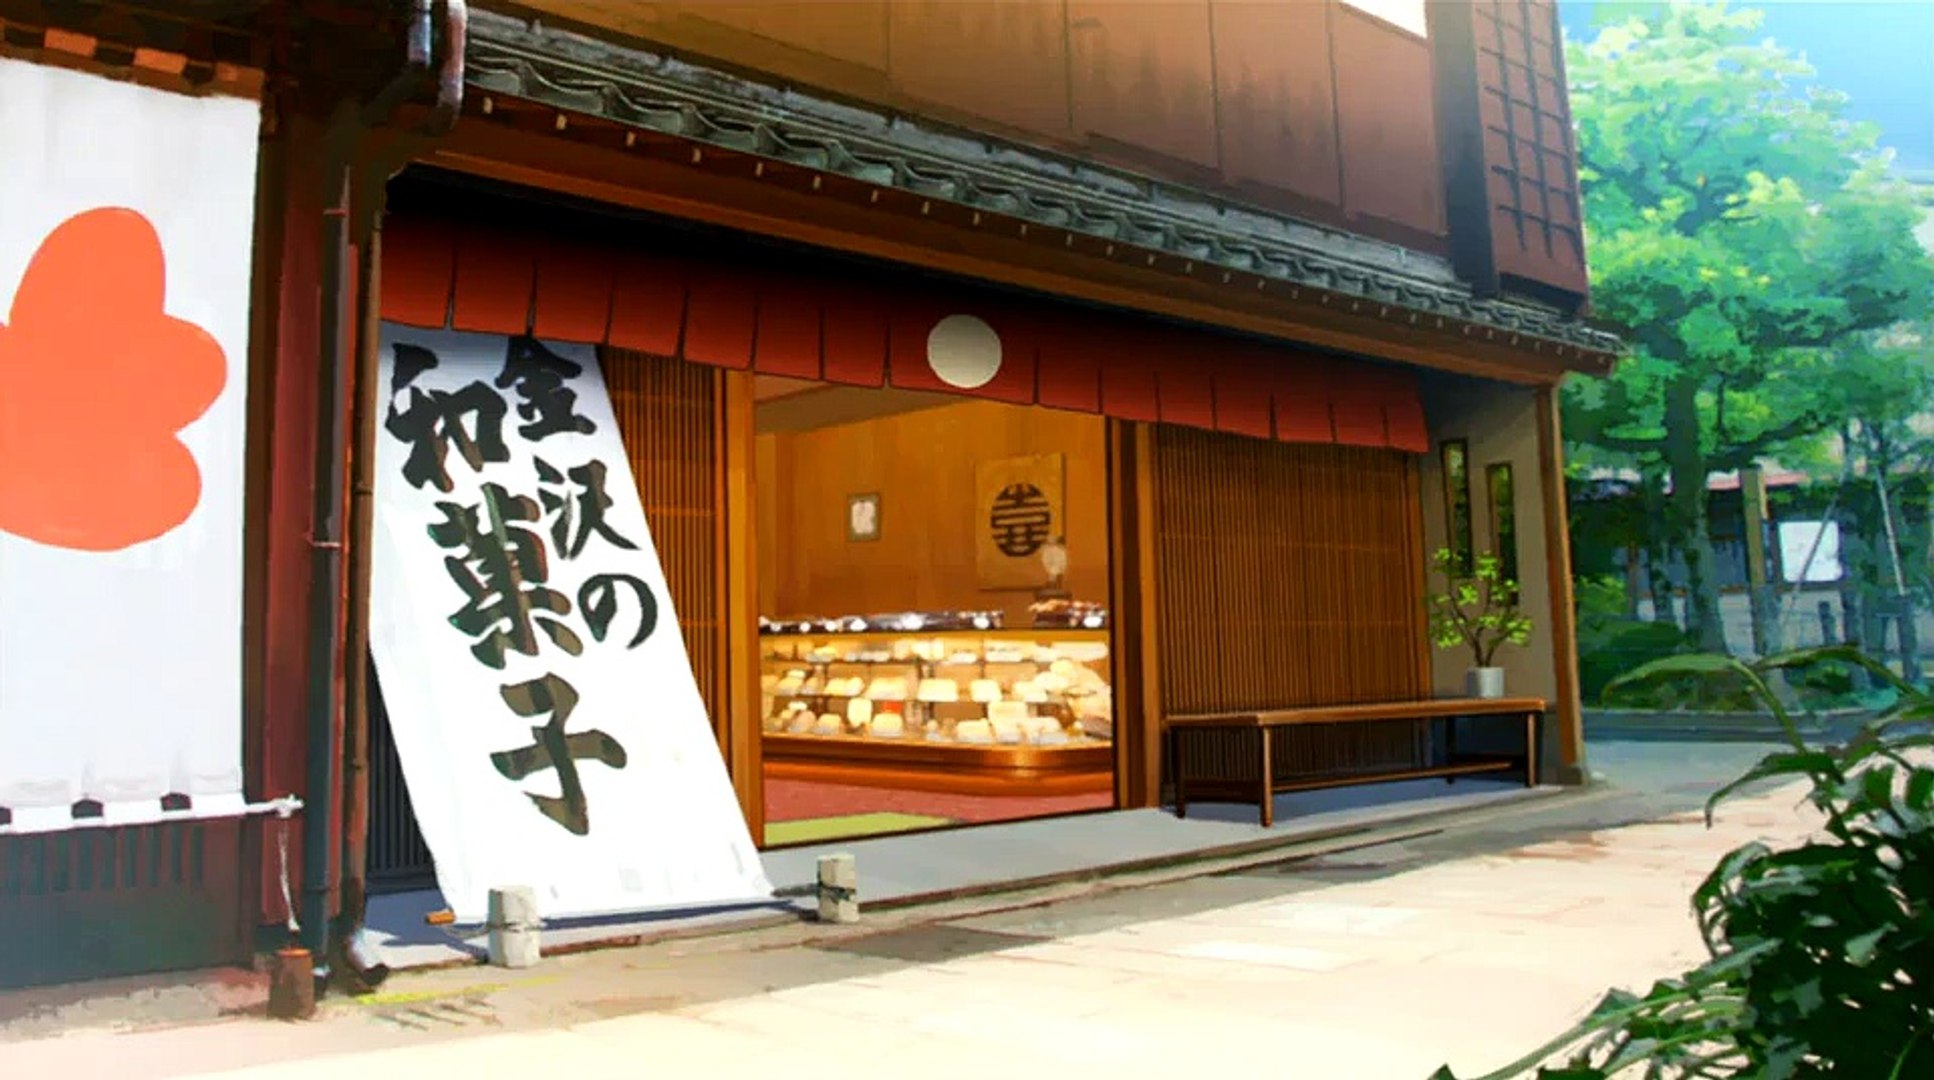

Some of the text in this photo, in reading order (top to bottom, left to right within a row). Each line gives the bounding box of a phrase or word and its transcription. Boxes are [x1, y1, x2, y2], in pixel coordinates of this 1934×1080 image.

[384, 343, 627, 835] 和菓子
[494, 334, 658, 648] 金沢の
